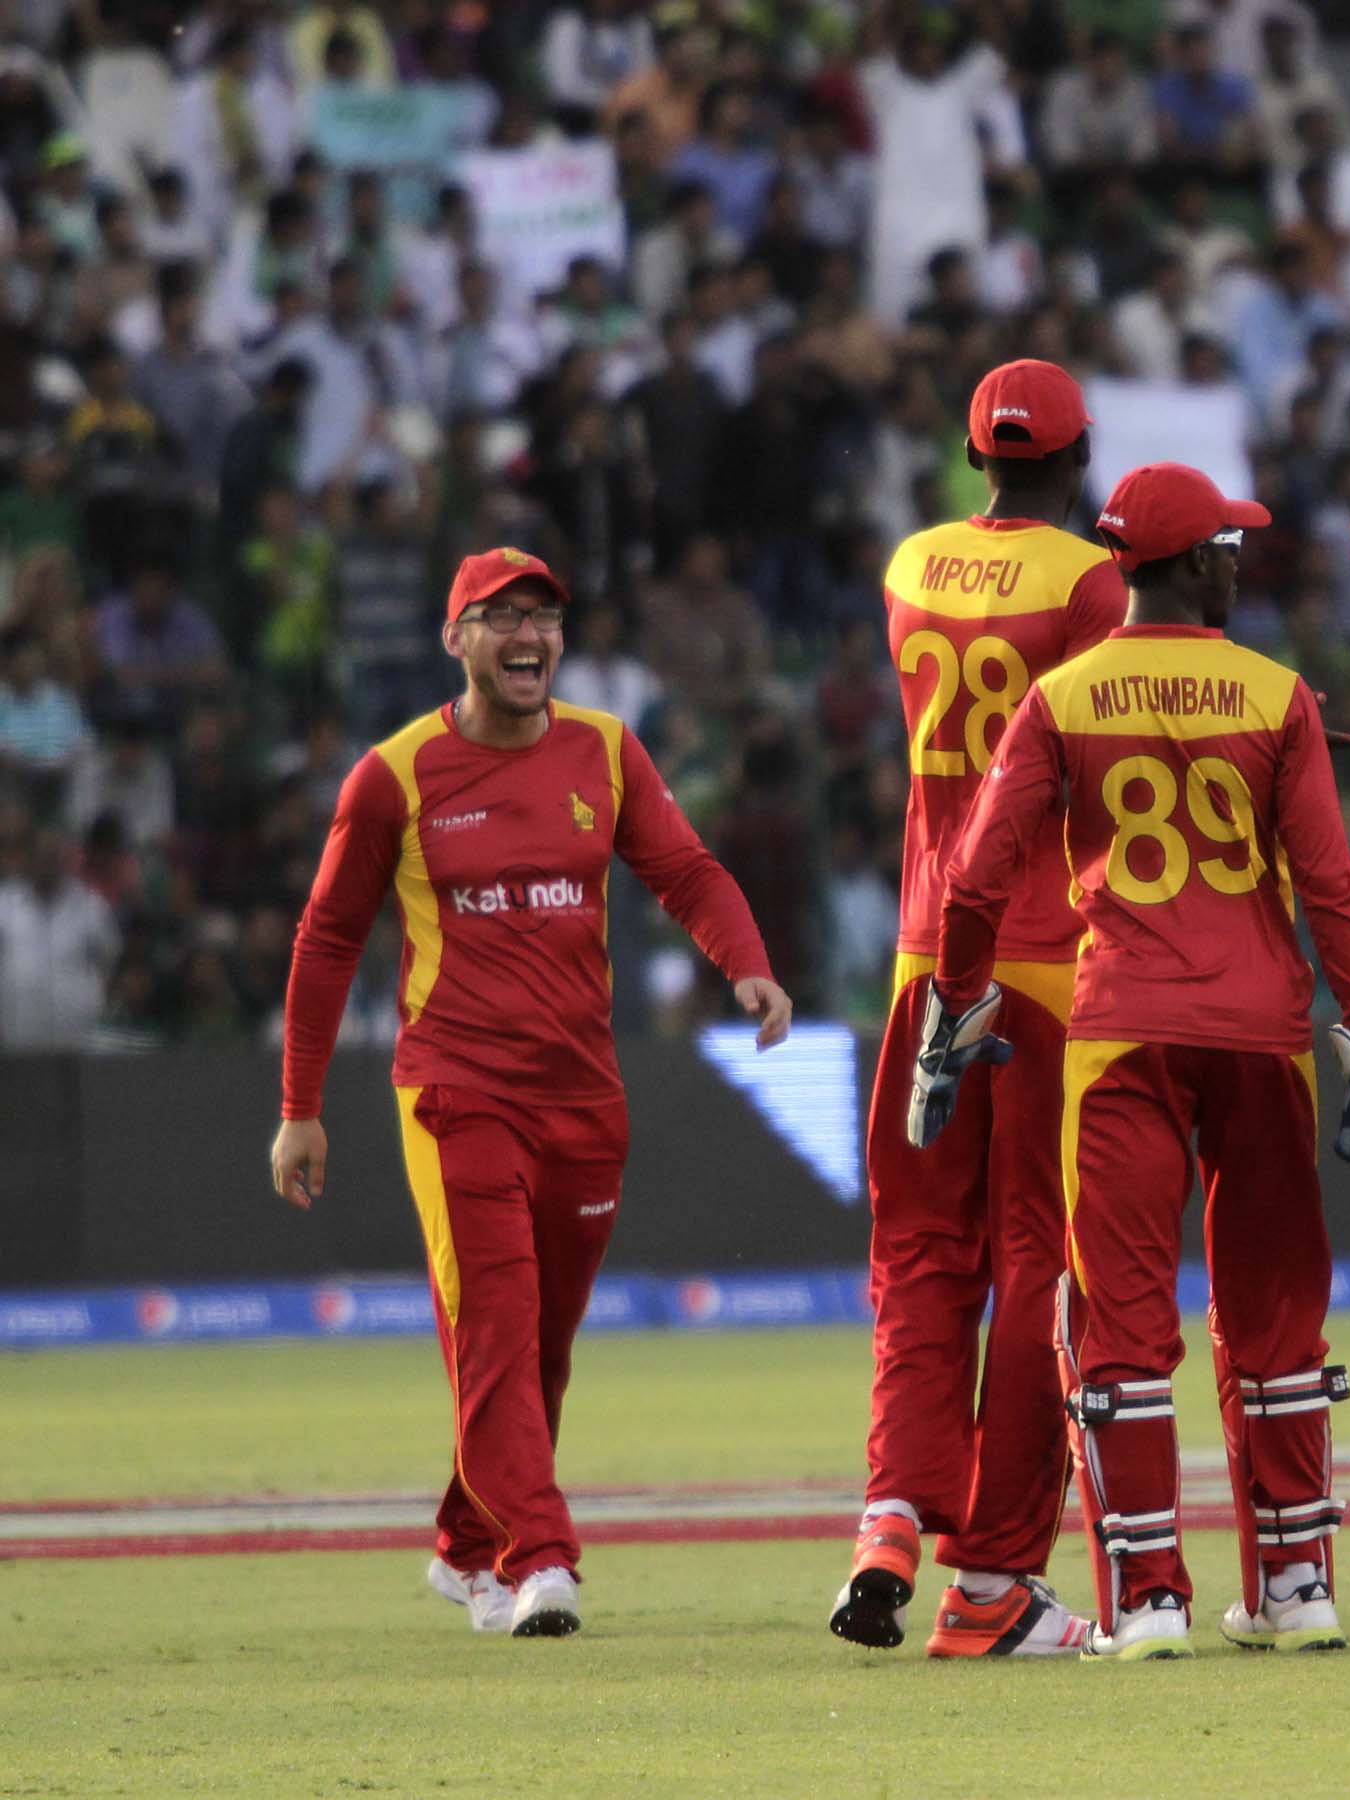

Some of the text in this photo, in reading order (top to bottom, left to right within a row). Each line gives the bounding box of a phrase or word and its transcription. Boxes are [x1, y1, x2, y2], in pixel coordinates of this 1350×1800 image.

[920, 554, 1023, 598] MPOFU
[900, 630, 1030, 776] 28
[1090, 675, 1245, 721] MUTUMBAMI
[1102, 755, 1267, 904] 89
[453, 877, 584, 914] Katundu
